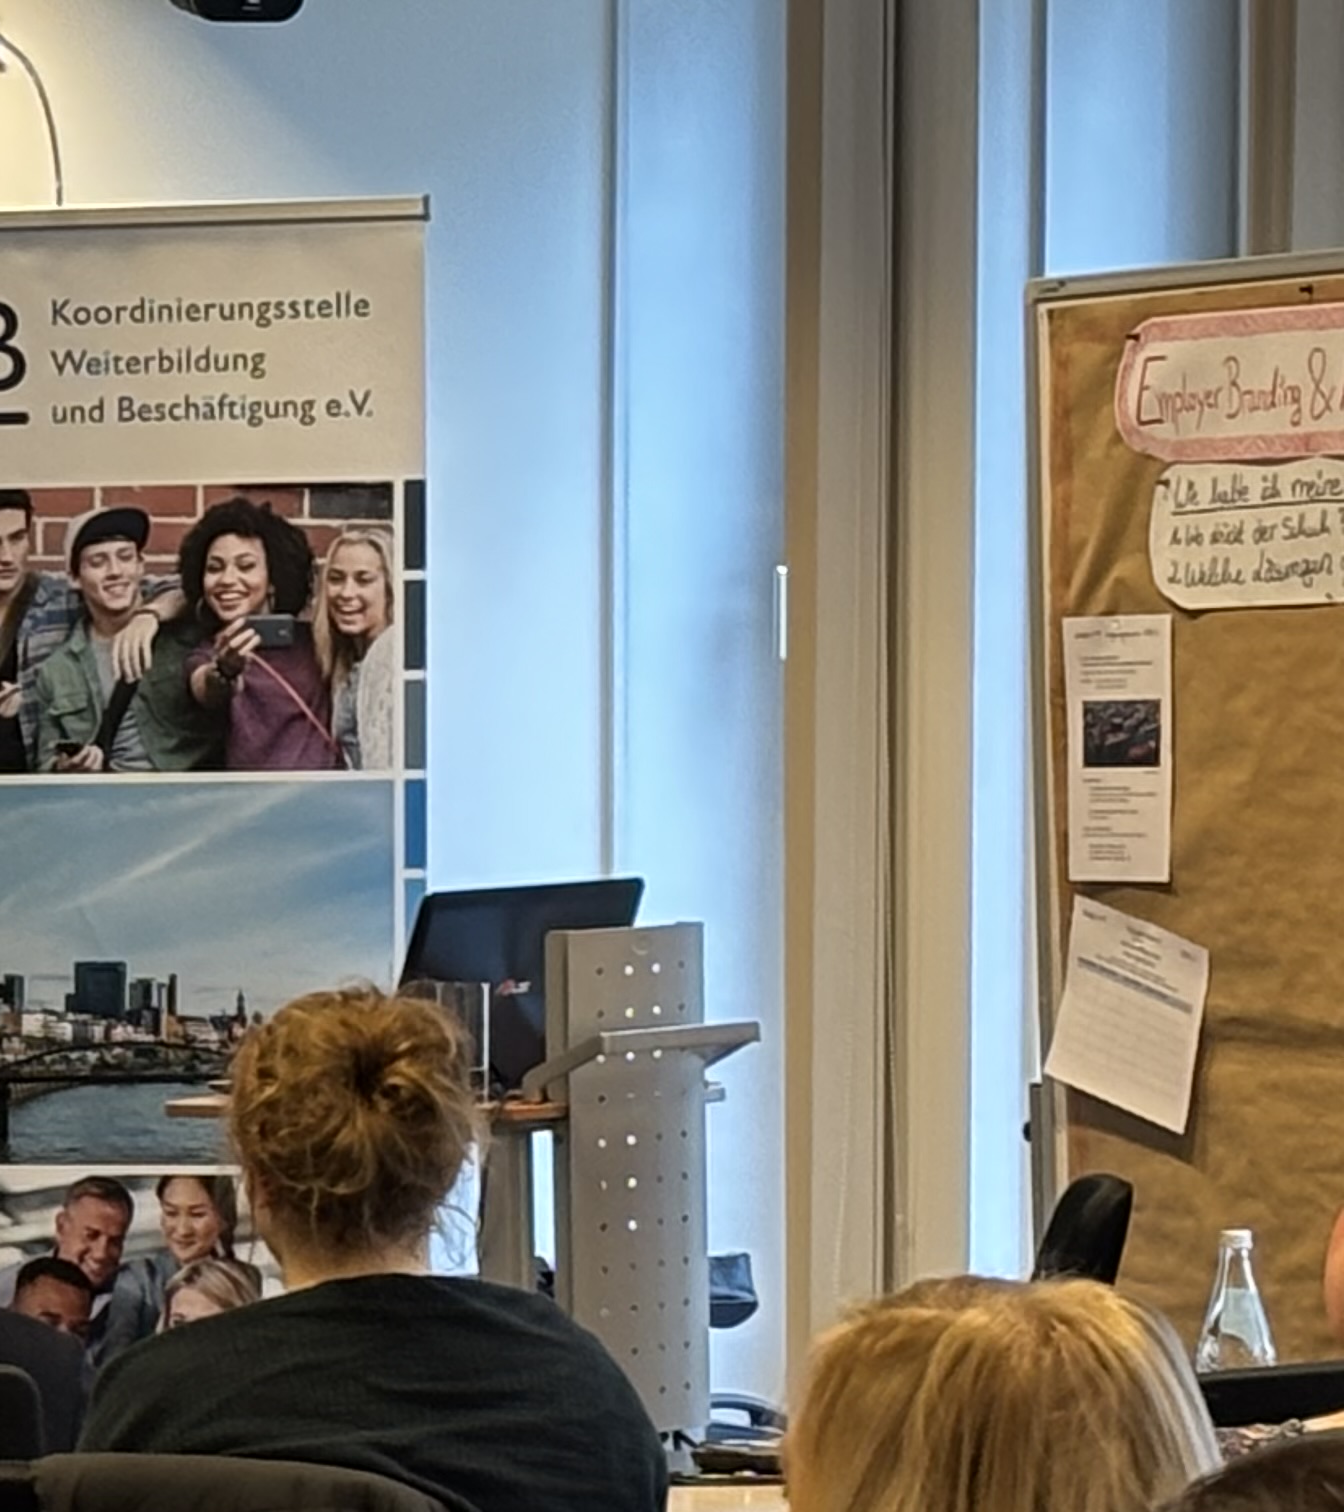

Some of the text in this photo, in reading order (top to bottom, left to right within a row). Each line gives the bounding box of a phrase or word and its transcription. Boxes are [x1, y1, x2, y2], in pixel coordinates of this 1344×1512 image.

[50, 290, 370, 329] Koordinierungsstelle
[50, 346, 266, 379] Weiterbildung
[51, 389, 373, 428] und Beschäftigung e.V.
[1136, 347, 1336, 435] Employer Branding &
